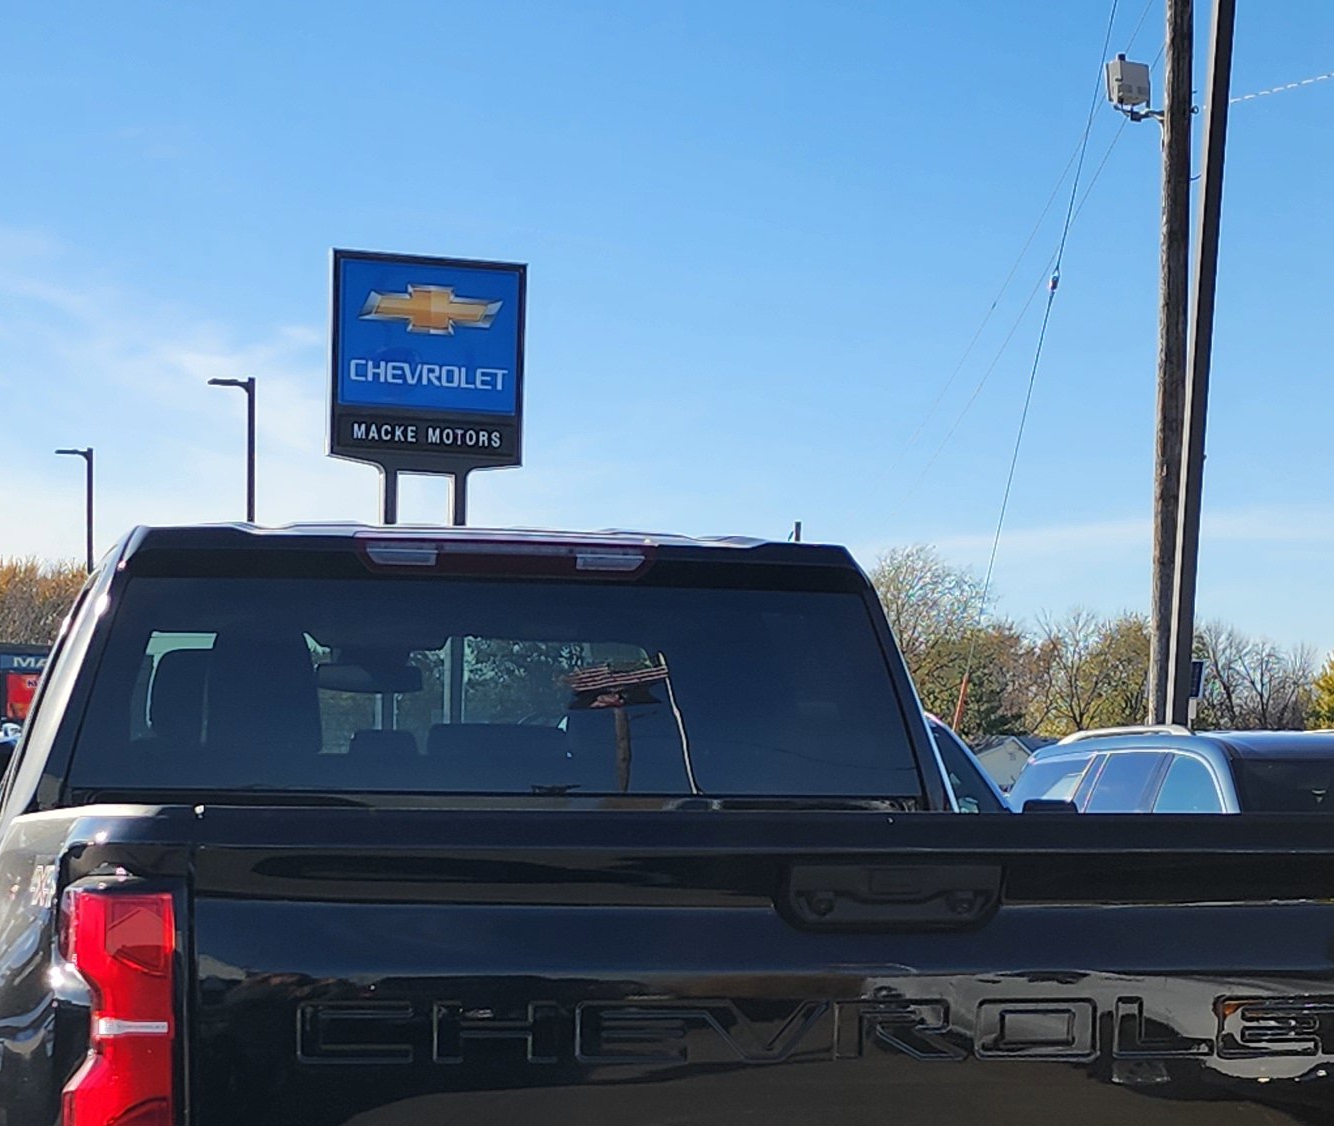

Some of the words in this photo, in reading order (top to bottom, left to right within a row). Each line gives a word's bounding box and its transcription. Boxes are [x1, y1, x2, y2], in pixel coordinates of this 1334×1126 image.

[349, 359, 509, 391] CHEVROLET
[353, 422, 417, 442] MACKE
[427, 427, 502, 448] MOTORS
[13, 657, 48, 668] MA
